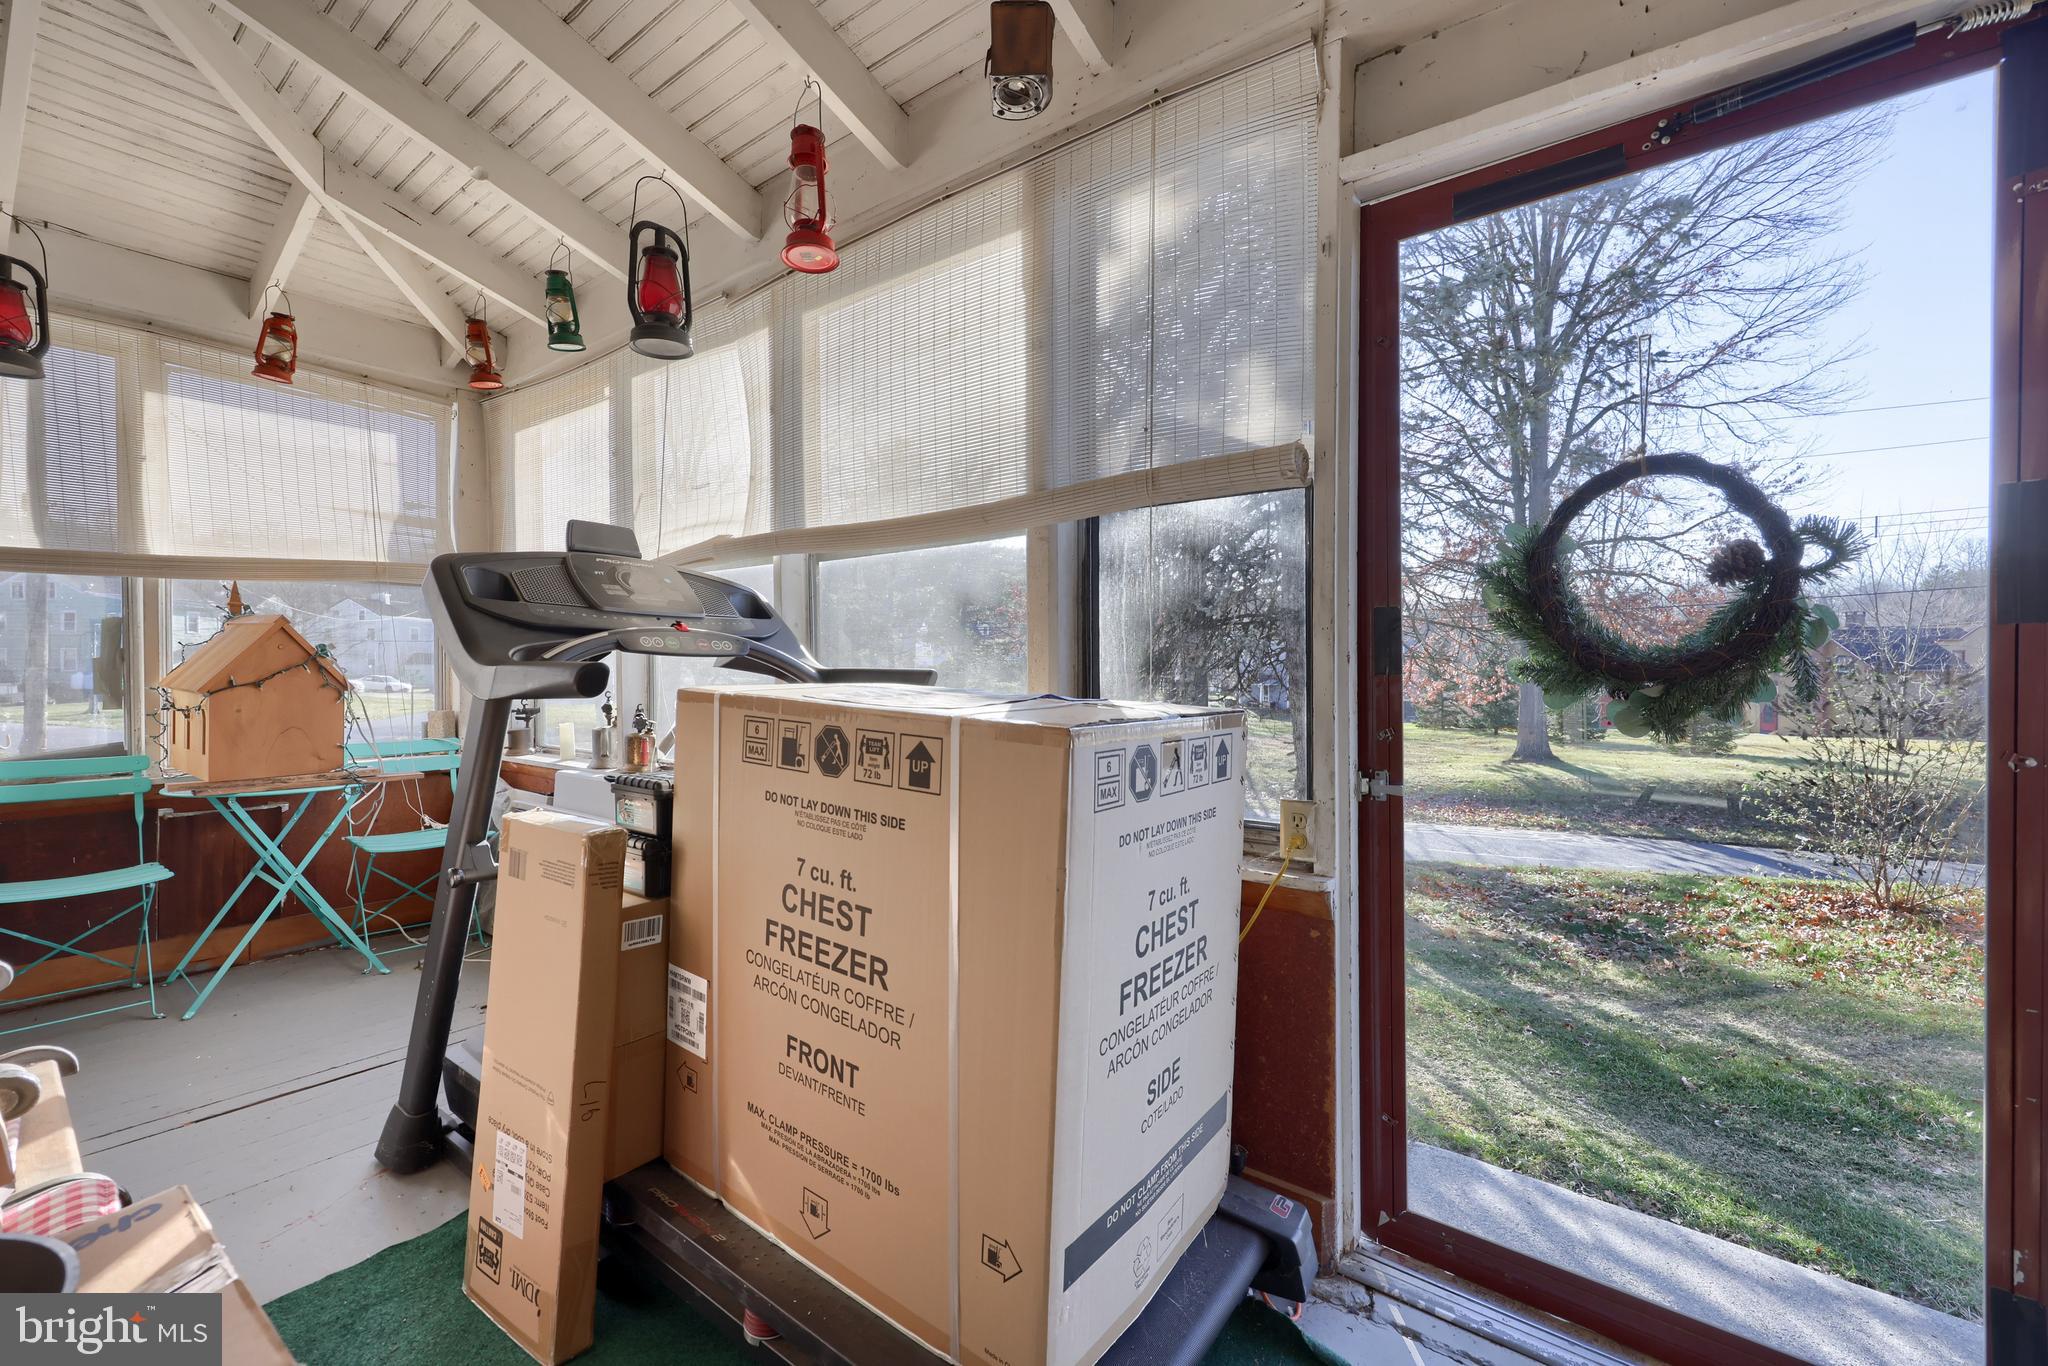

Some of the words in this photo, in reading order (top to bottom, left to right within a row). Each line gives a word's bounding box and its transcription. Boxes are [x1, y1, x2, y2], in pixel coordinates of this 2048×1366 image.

[754, 725, 760, 735] 6
[748, 745, 765, 757] MAX
[1218, 754, 1227, 766] UP
[862, 768, 872, 779] 72
[874, 770, 881, 780] lb
[912, 760, 929, 773] UP
[1106, 761, 1112, 773] 6
[1100, 786, 1118, 800] MAX
[765, 790, 778, 803] DO
[780, 793, 799, 807] NOT
[801, 797, 819, 811] LAY
[820, 801, 850, 818] DOWN
[854, 809, 877, 824] THIS
[880, 815, 906, 831] SIDE
[830, 817, 842, 827] PAS
[842, 820, 851, 828] CE
[796, 820, 806, 829] NO
[806, 822, 832, 835] COLOQUE
[832, 828, 848, 838] ESTE
[848, 830, 864, 841] LADO
[1119, 833, 1132, 848] DO
[1133, 828, 1150, 844] NOT
[1151, 821, 1166, 838] LAY
[1166, 815, 1188, 833] DOWN
[1188, 811, 1202, 826] THIS
[1203, 806, 1217, 821] SIDE
[796, 857, 806, 877] 7
[810, 866, 835, 886] cu.
[840, 869, 857, 892] ft.
[1148, 889, 1156, 911] 7
[1159, 886, 1176, 907] cu.
[1180, 876, 1190, 898] ft.
[781, 883, 873, 937] CHEST
[1135, 898, 1200, 959] CHEST
[765, 918, 889, 992] FREEZER
[746, 948, 840, 1000] CONGELATÉUR
[844, 988, 905, 1026] COFFRE
[908, 1012, 915, 1029] /
[1120, 934, 1208, 1017] FREEZER
[753, 974, 798, 1005] ARCÓN
[800, 994, 902, 1050] CONGELADOR
[1100, 990, 1180, 1057] CONGELATÉUR
[1181, 968, 1215, 1003] COFFRE
[674, 1024, 696, 1038] HOTPOINT
[1107, 1034, 1150, 1079] ARCÓN
[1151, 988, 1213, 1047] CONGELADOR
[786, 1034, 860, 1089] FRONT
[778, 1062, 866, 1117] DEVANT/FRENTE
[1146, 1056, 1181, 1106] SIDE
[488, 1116, 502, 1131] place
[529, 1142, 536, 1154] in
[536, 1147, 553, 1164] Store
[747, 1101, 767, 1121] MAX.
[768, 1114, 799, 1137] CLAMP
[800, 1130, 850, 1168] PRESSURE
[860, 1166, 882, 1187] 1700
[884, 1178, 900, 1196] lbs
[760, 1121, 773, 1134] MAX.
[796, 1142, 804, 1152] DE
[805, 1146, 813, 1156] LA
[812, 1150, 852, 1180] ABRAZADERA
[858, 1177, 871, 1191] 1700
[871, 1184, 881, 1196] lbs
[536, 1165, 552, 1182] PO#:
[768, 1135, 782, 1148] MAX.
[808, 1158, 816, 1169] DE
[817, 1163, 845, 1186] SERRAGE
[850, 1184, 864, 1196] 1700
[1106, 1209, 1120, 1228] DO
[1120, 1192, 1137, 1216] NOT
[1137, 1170, 1160, 1200] CLAMP
[1160, 1150, 1178, 1176] FROM
[1178, 1136, 1191, 1154] THIS
[1190, 1122, 1204, 1142] SIDE
[535, 1181, 550, 1198] Case
[524, 1207, 534, 1221] Sto
[534, 1198, 550, 1214] Item:
[480, 1222, 497, 1239] CAUTION
[534, 1214, 549, 1230] Foot
